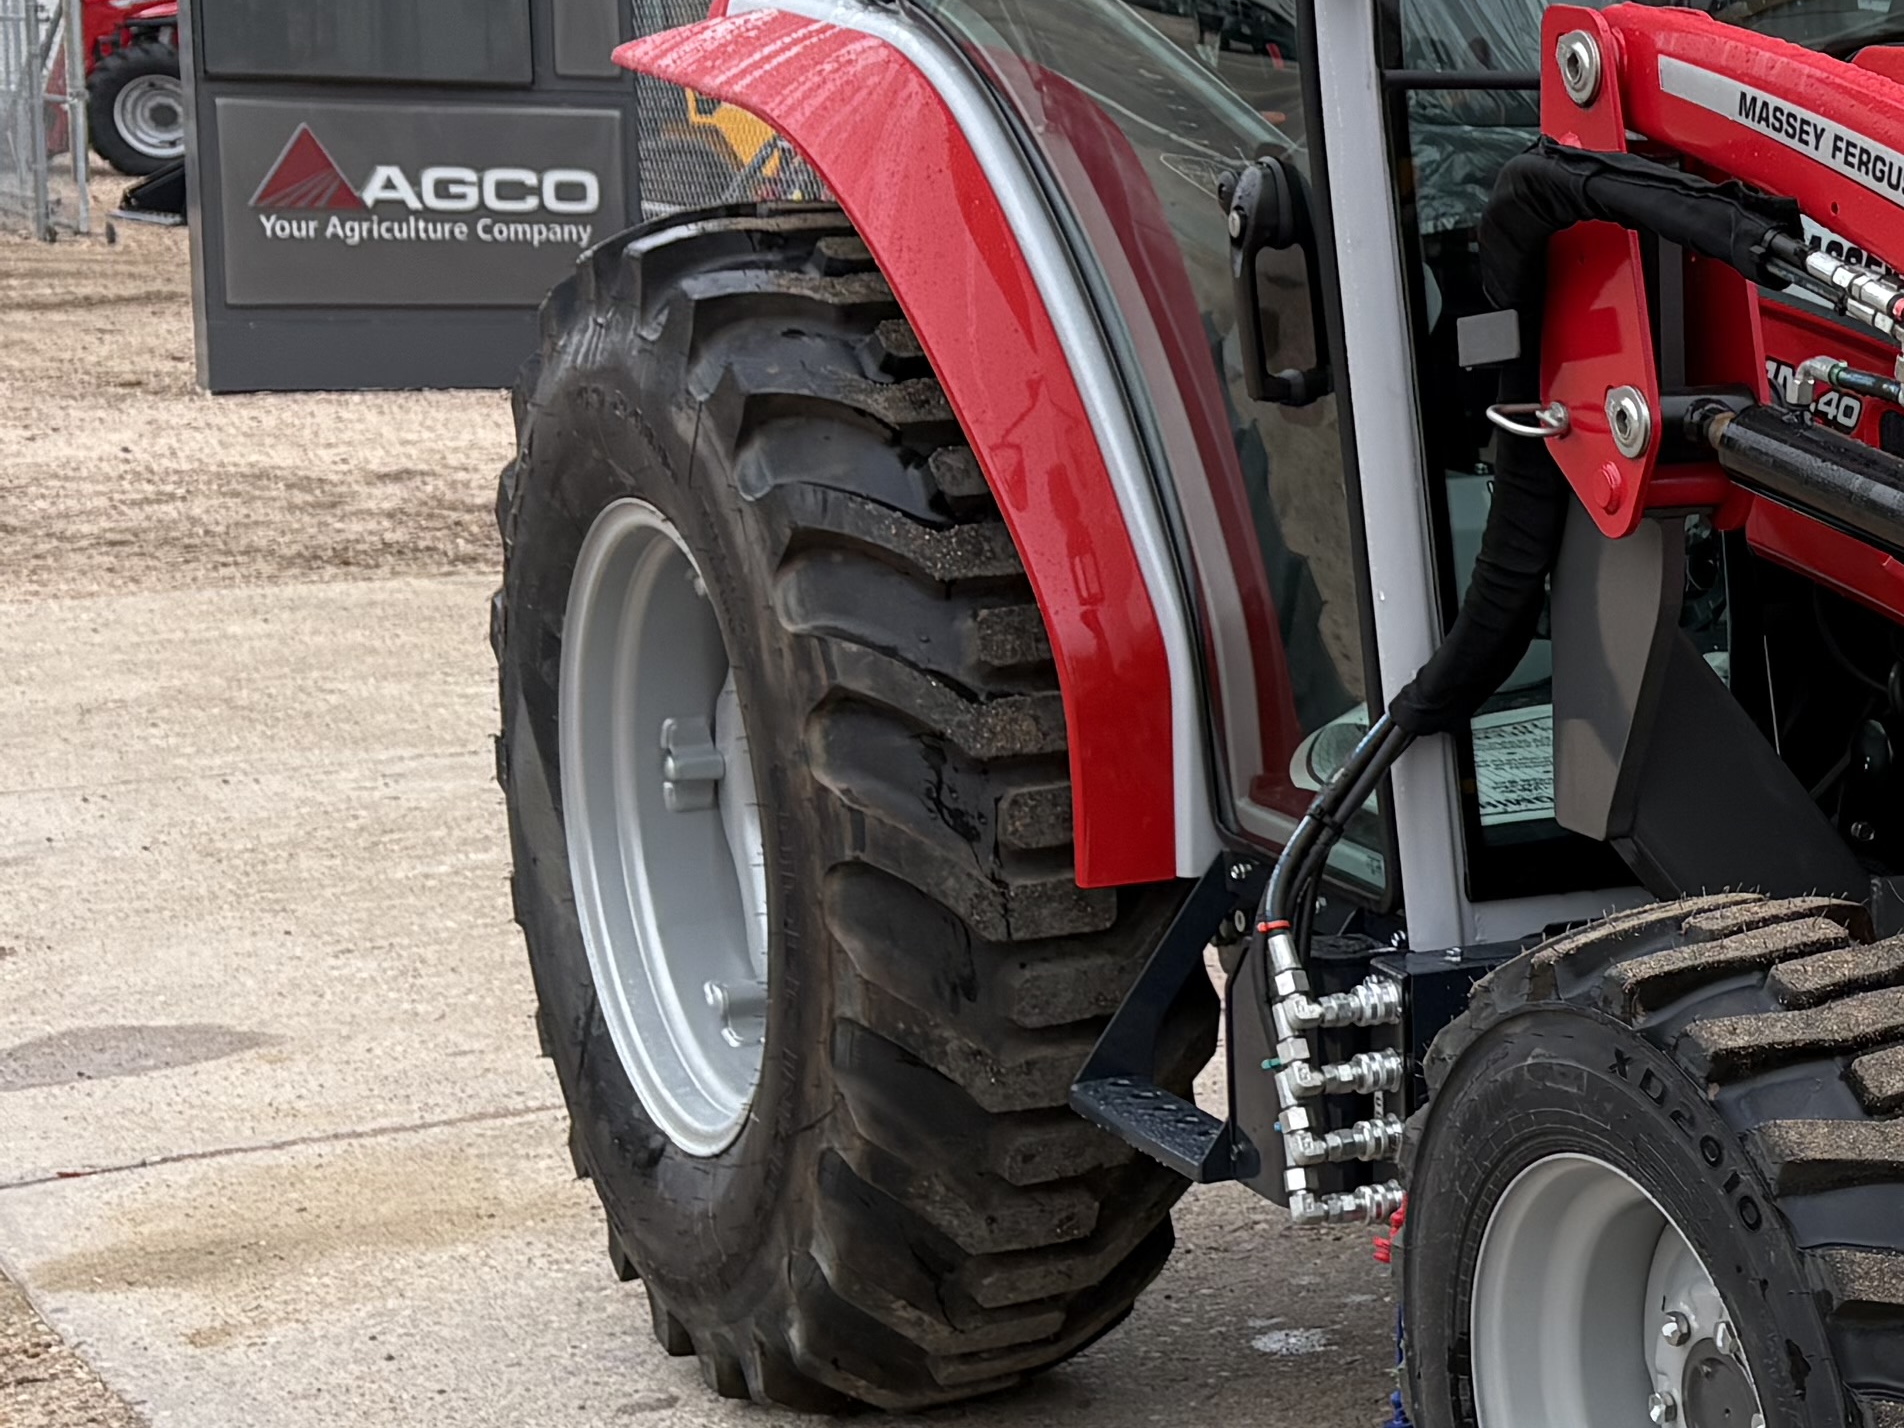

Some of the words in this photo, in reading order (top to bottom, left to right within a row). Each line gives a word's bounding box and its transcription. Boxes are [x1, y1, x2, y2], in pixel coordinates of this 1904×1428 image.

[1738, 91, 1825, 152] MASSEY
[361, 165, 600, 213] AGCO
[260, 214, 319, 239] Your
[326, 215, 468, 246] Agriculture
[477, 218, 593, 248] Company
